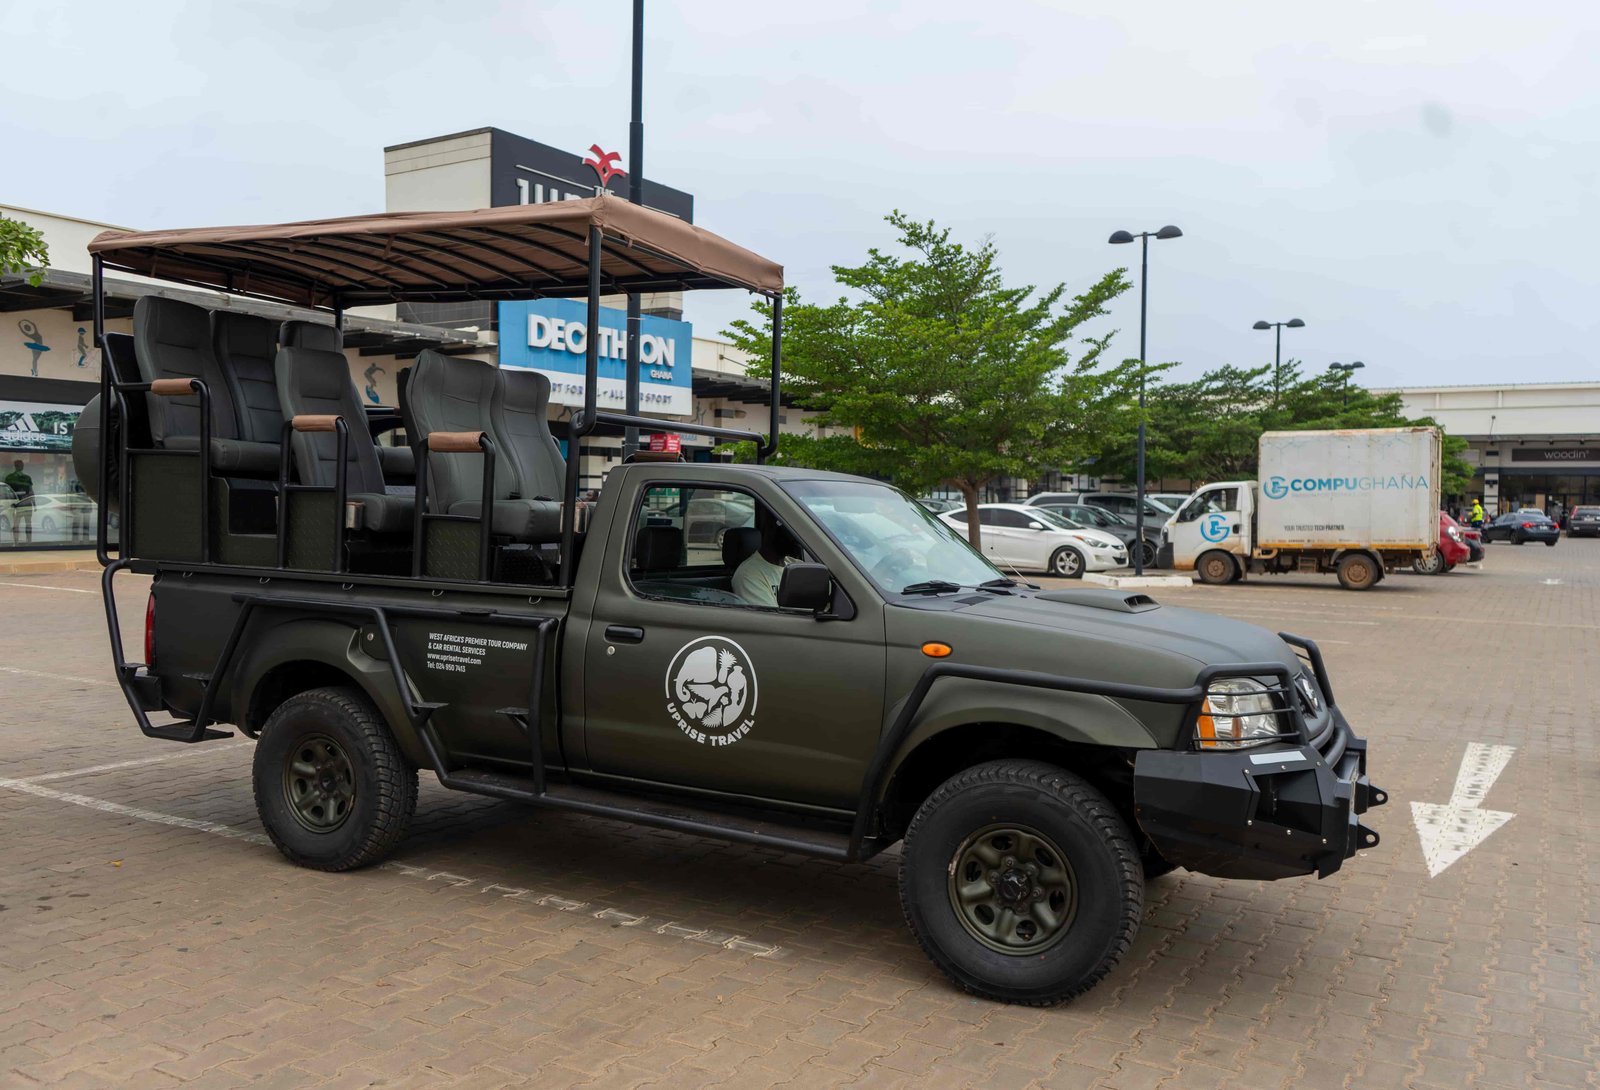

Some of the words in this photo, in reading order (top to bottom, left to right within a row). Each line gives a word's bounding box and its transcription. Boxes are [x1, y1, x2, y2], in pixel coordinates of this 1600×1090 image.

[528, 313, 675, 367] DECTHON
[650, 369, 673, 381] GHANA
[645, 393, 673, 405] SPORT
[53, 421, 68, 435] IS
[2, 431, 47, 442] adidas
[1544, 450, 1586, 459] woodin
[1295, 524, 1313, 532] TRUSTED
[1314, 524, 1325, 532] TECH
[1325, 524, 1345, 532] PARTNER
[429, 632, 444, 641] WEST
[443, 634, 464, 644] AFRICA'S
[465, 636, 488, 646] PREMIER
[488, 639, 502, 648] TOUR
[502, 641, 528, 651] COMPANY
[432, 643, 443, 651] CAR
[443, 644, 461, 653] RENTAL
[462, 646, 486, 656] SERVICES
[427, 653, 482, 665] www.uprisetravel.com
[435, 662, 445, 670] 024
[666, 702, 706, 744] UPRISE
[709, 719, 755, 747] TRAVEL
